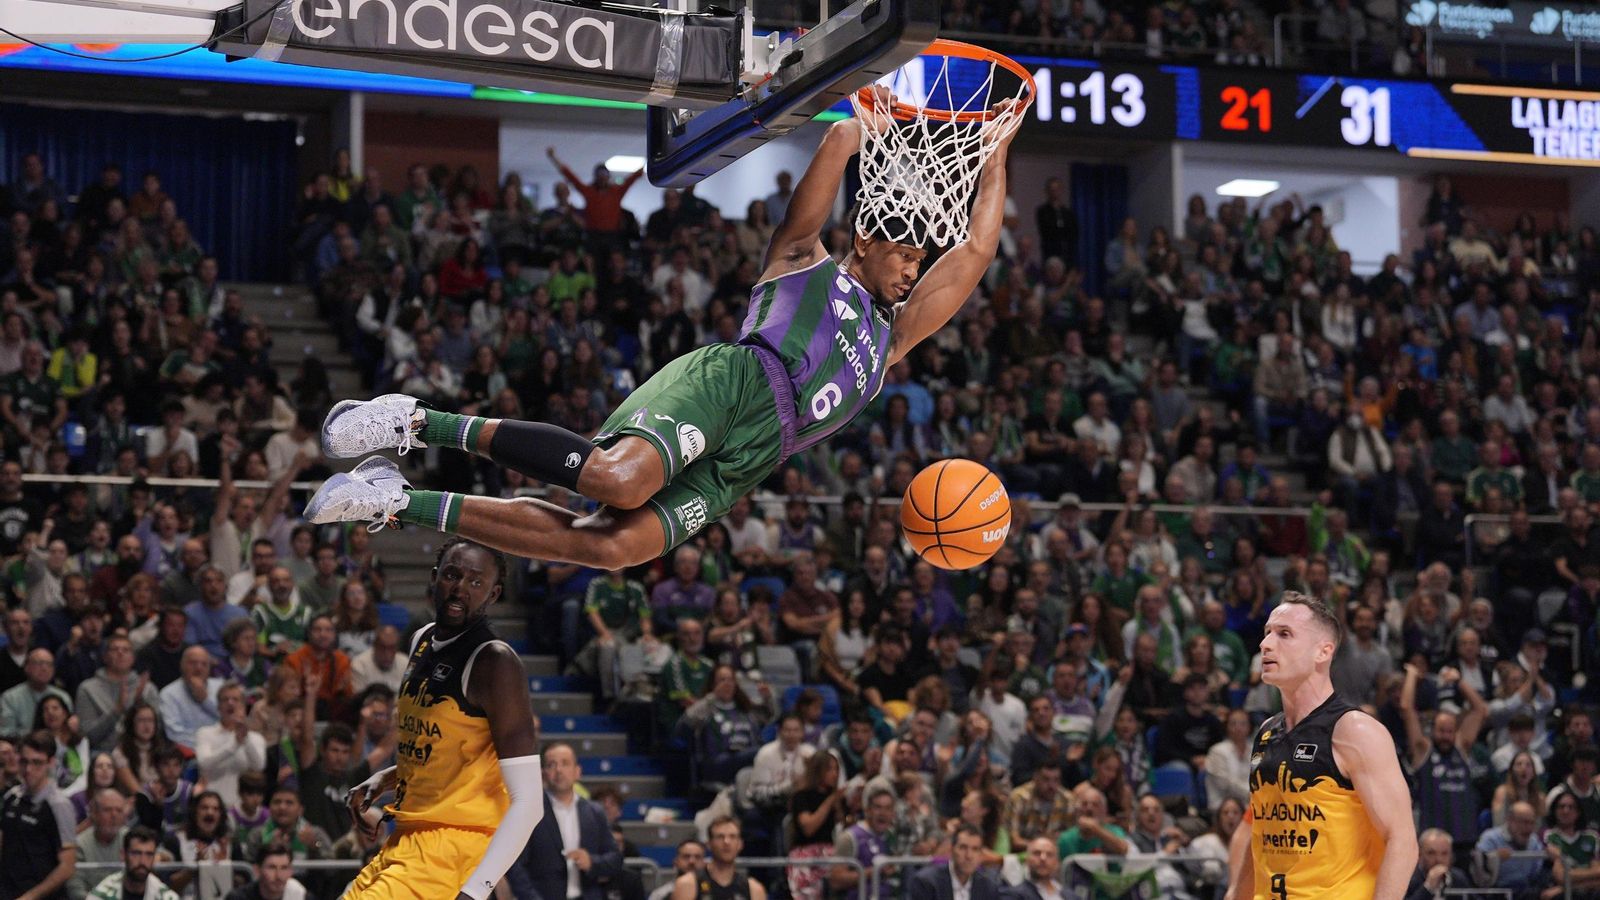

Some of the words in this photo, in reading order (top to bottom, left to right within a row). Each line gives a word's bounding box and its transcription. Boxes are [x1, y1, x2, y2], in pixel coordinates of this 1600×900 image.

[292, 0, 614, 70] endesa
[1025, 67, 1146, 127] 1:13
[1220, 86, 1271, 132] 21
[1341, 86, 1391, 147] 31
[1511, 96, 1545, 129] LA
[812, 382, 842, 420] 6
[1271, 874, 1287, 900] 9
